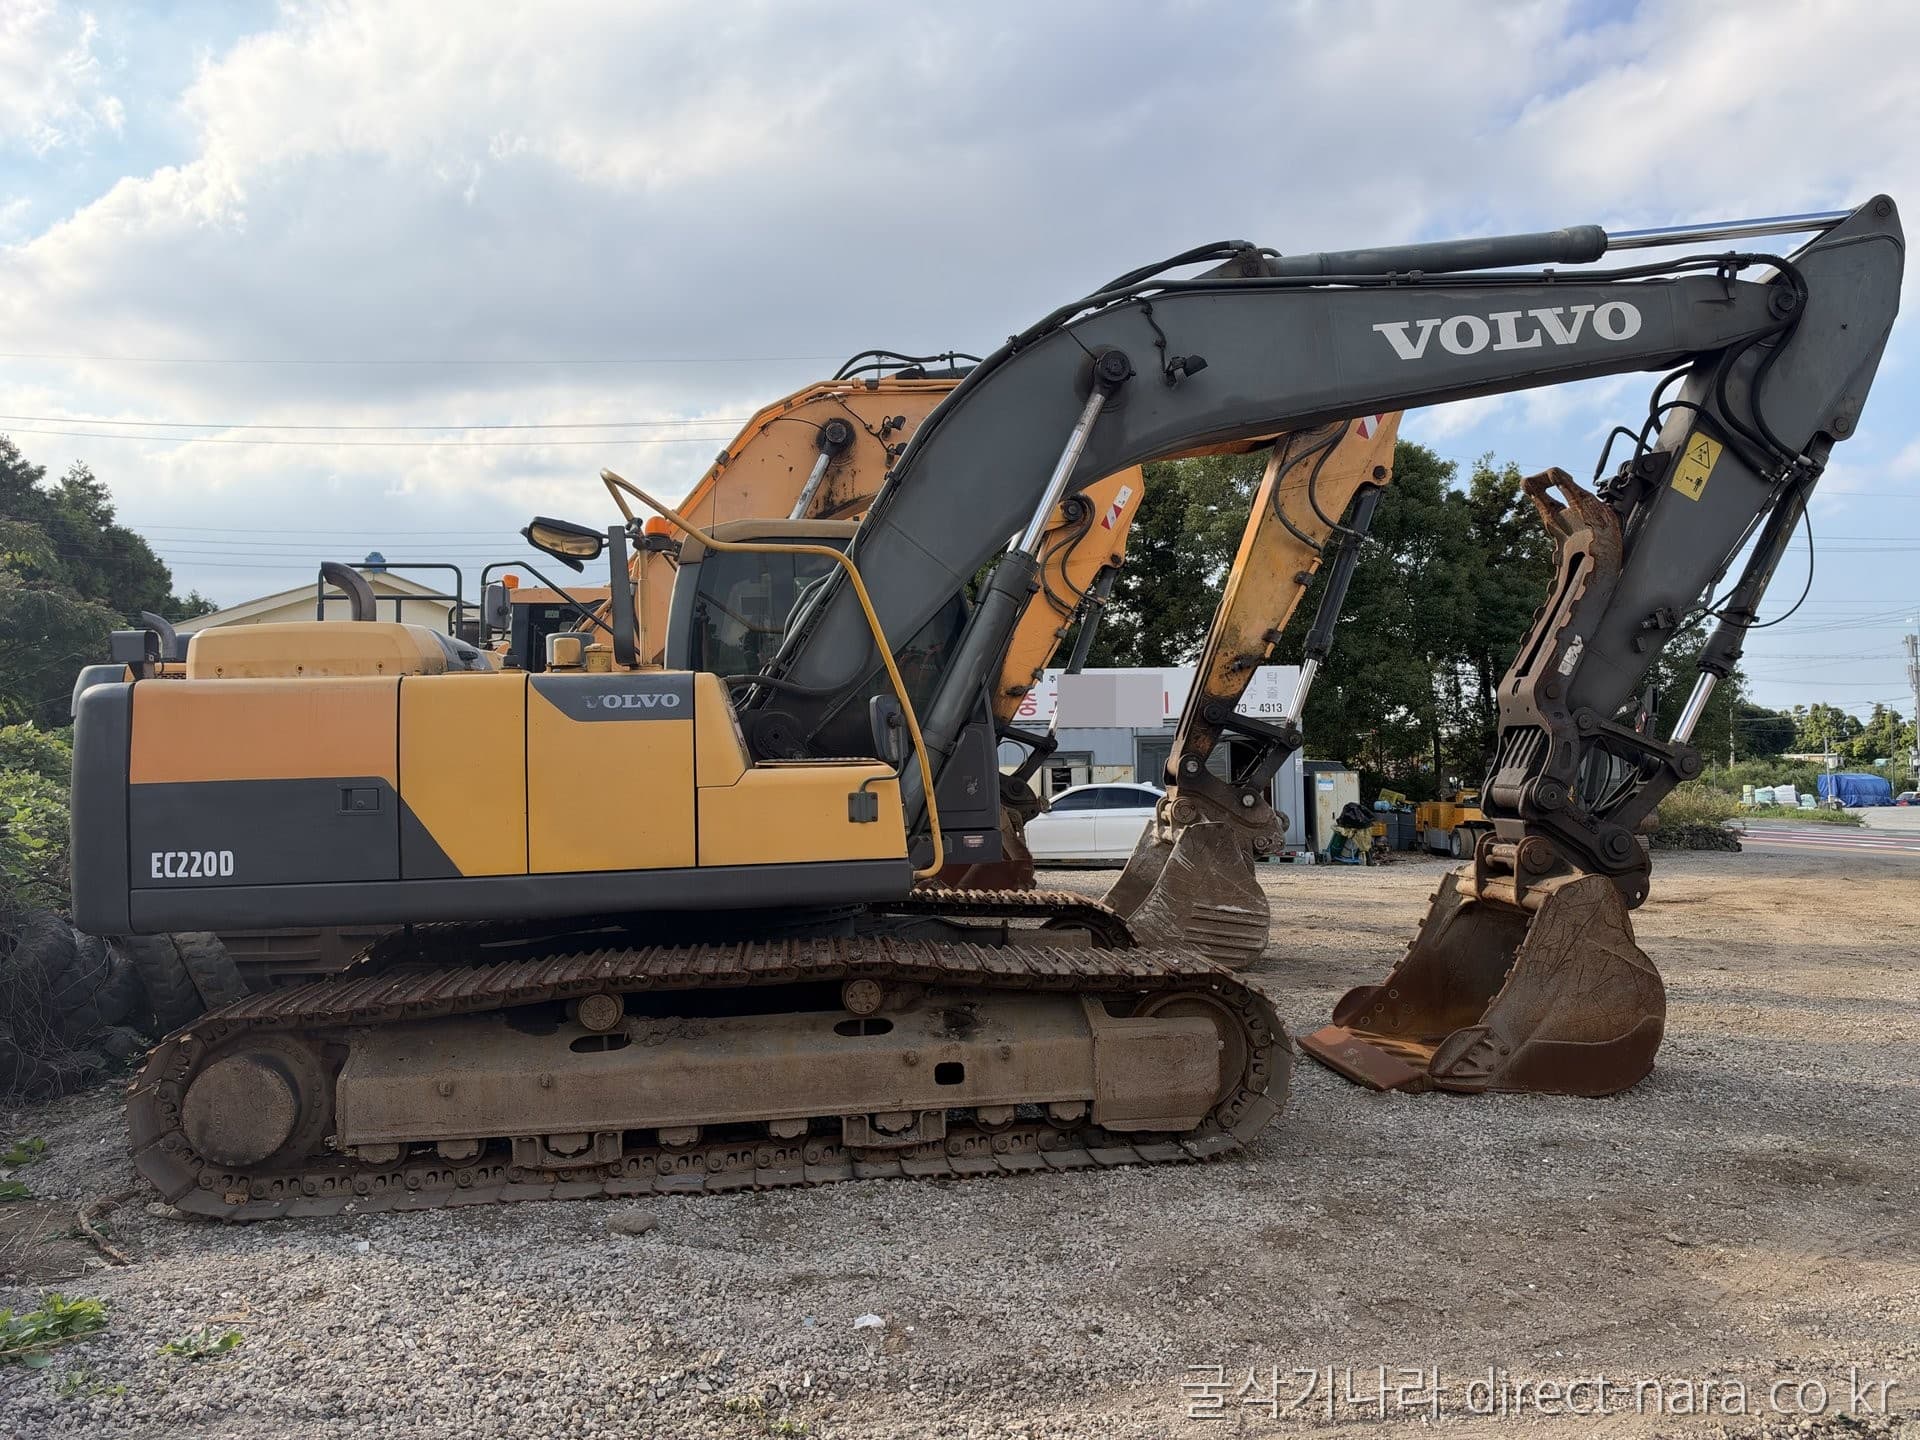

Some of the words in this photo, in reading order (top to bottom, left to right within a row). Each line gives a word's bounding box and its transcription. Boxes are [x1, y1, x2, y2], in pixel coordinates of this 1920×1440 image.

[1373, 301, 1642, 360] VOLVO
[582, 693, 680, 708] VOLVO
[151, 850, 234, 879] EC220D
